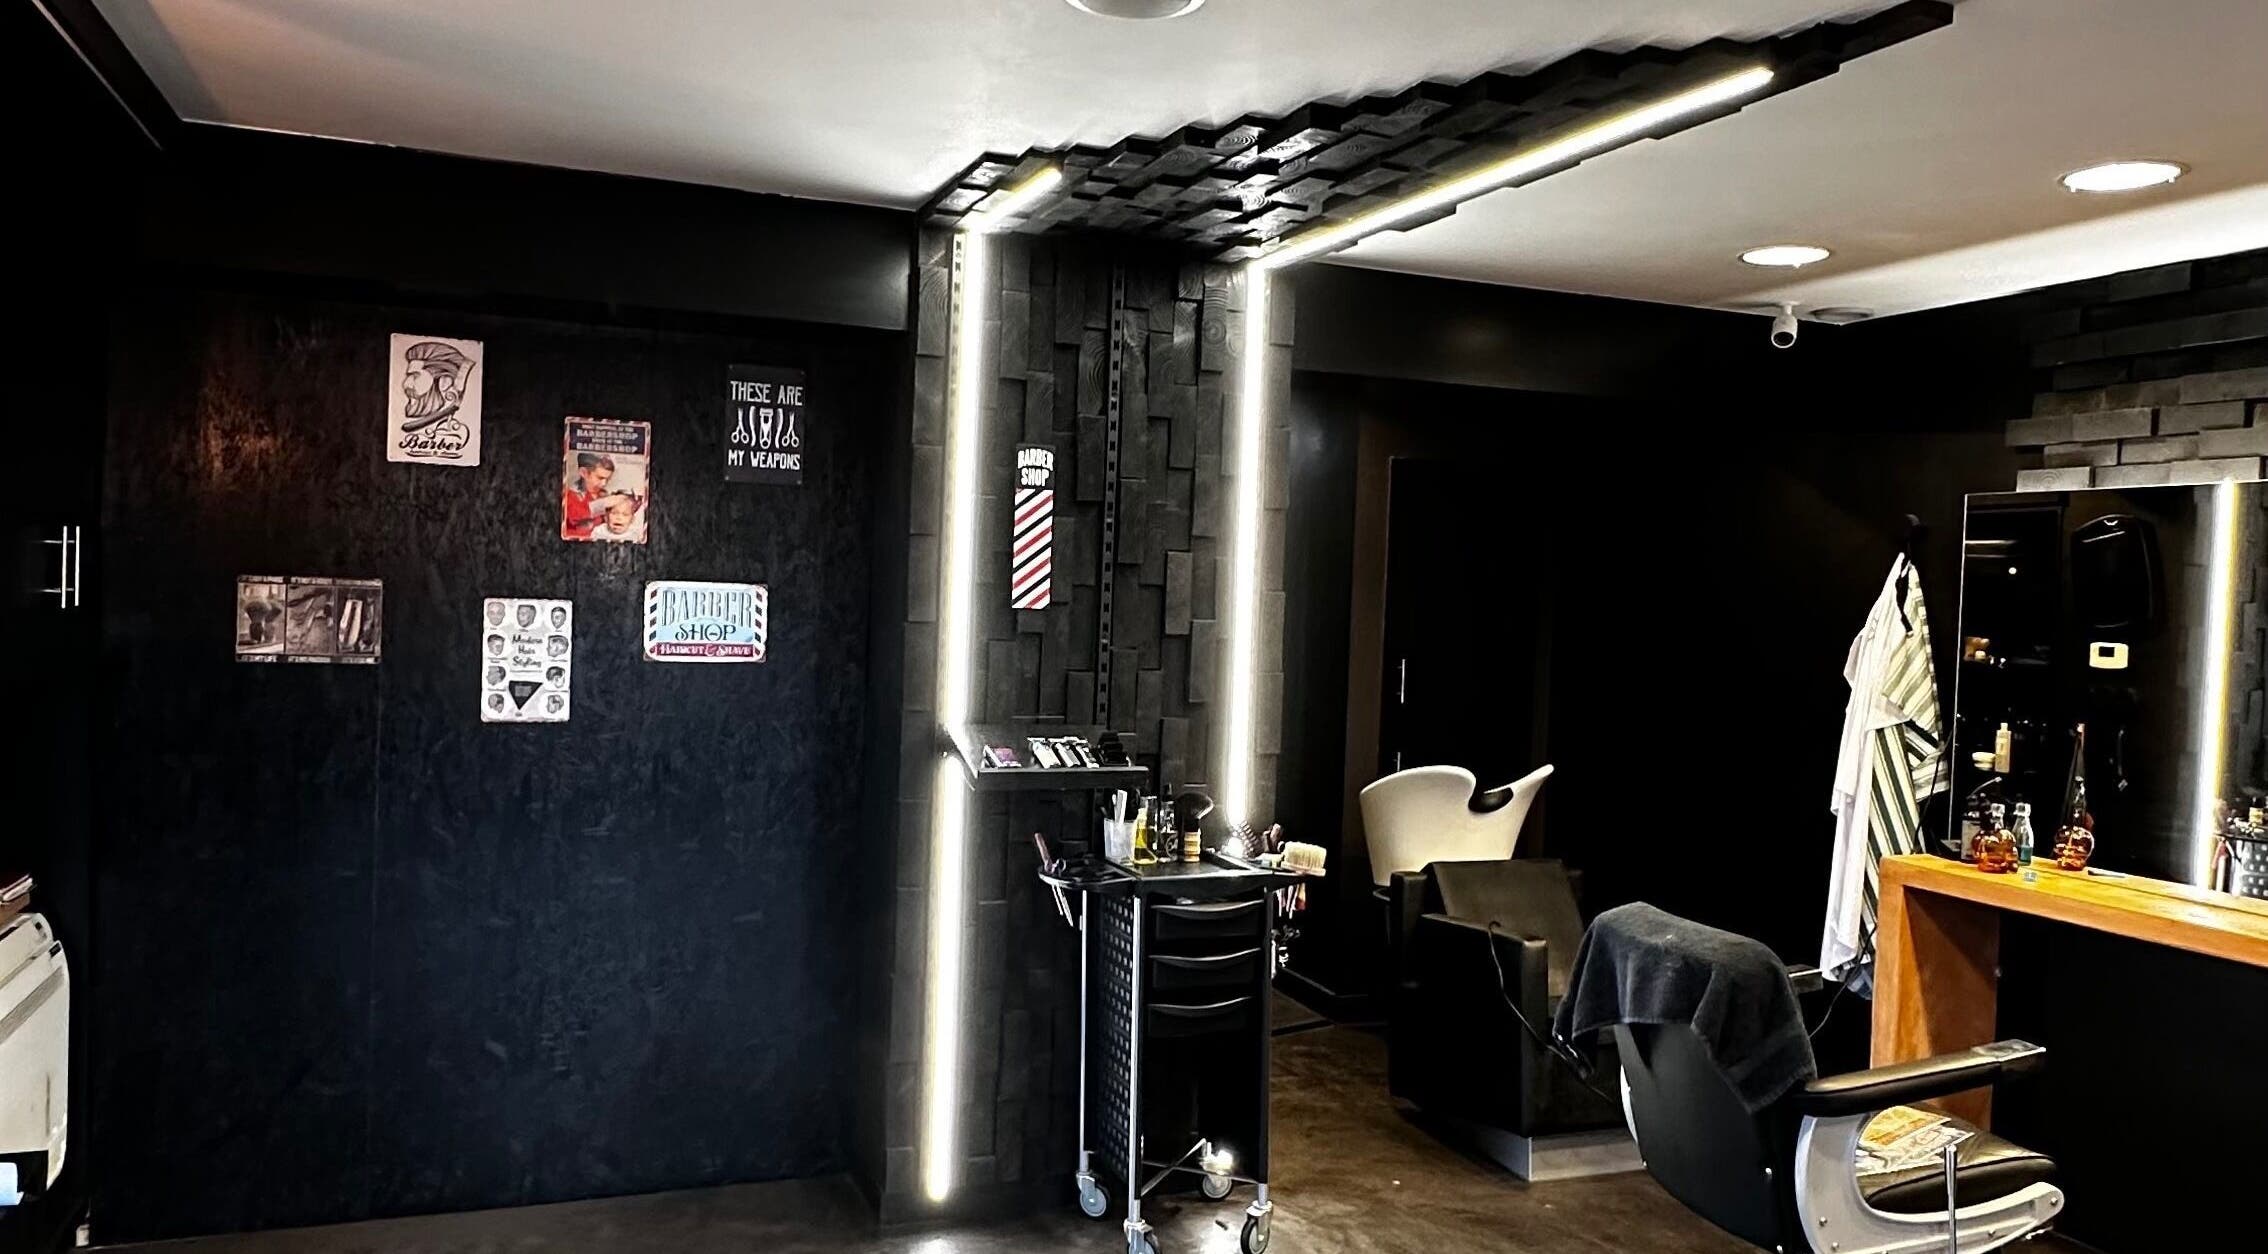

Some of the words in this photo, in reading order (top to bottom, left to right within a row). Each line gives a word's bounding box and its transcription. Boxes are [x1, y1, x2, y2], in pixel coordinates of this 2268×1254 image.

[730, 380, 772, 404] THESE
[777, 384, 804, 406] ARE
[398, 433, 465, 452] Barber
[727, 448, 745, 466] MY
[750, 450, 801, 471] WEAPONS
[1017, 448, 1054, 472] BARBER
[1021, 467, 1050, 487] SHOP
[661, 589, 752, 629] BARBER
[675, 623, 737, 642] SHOP
